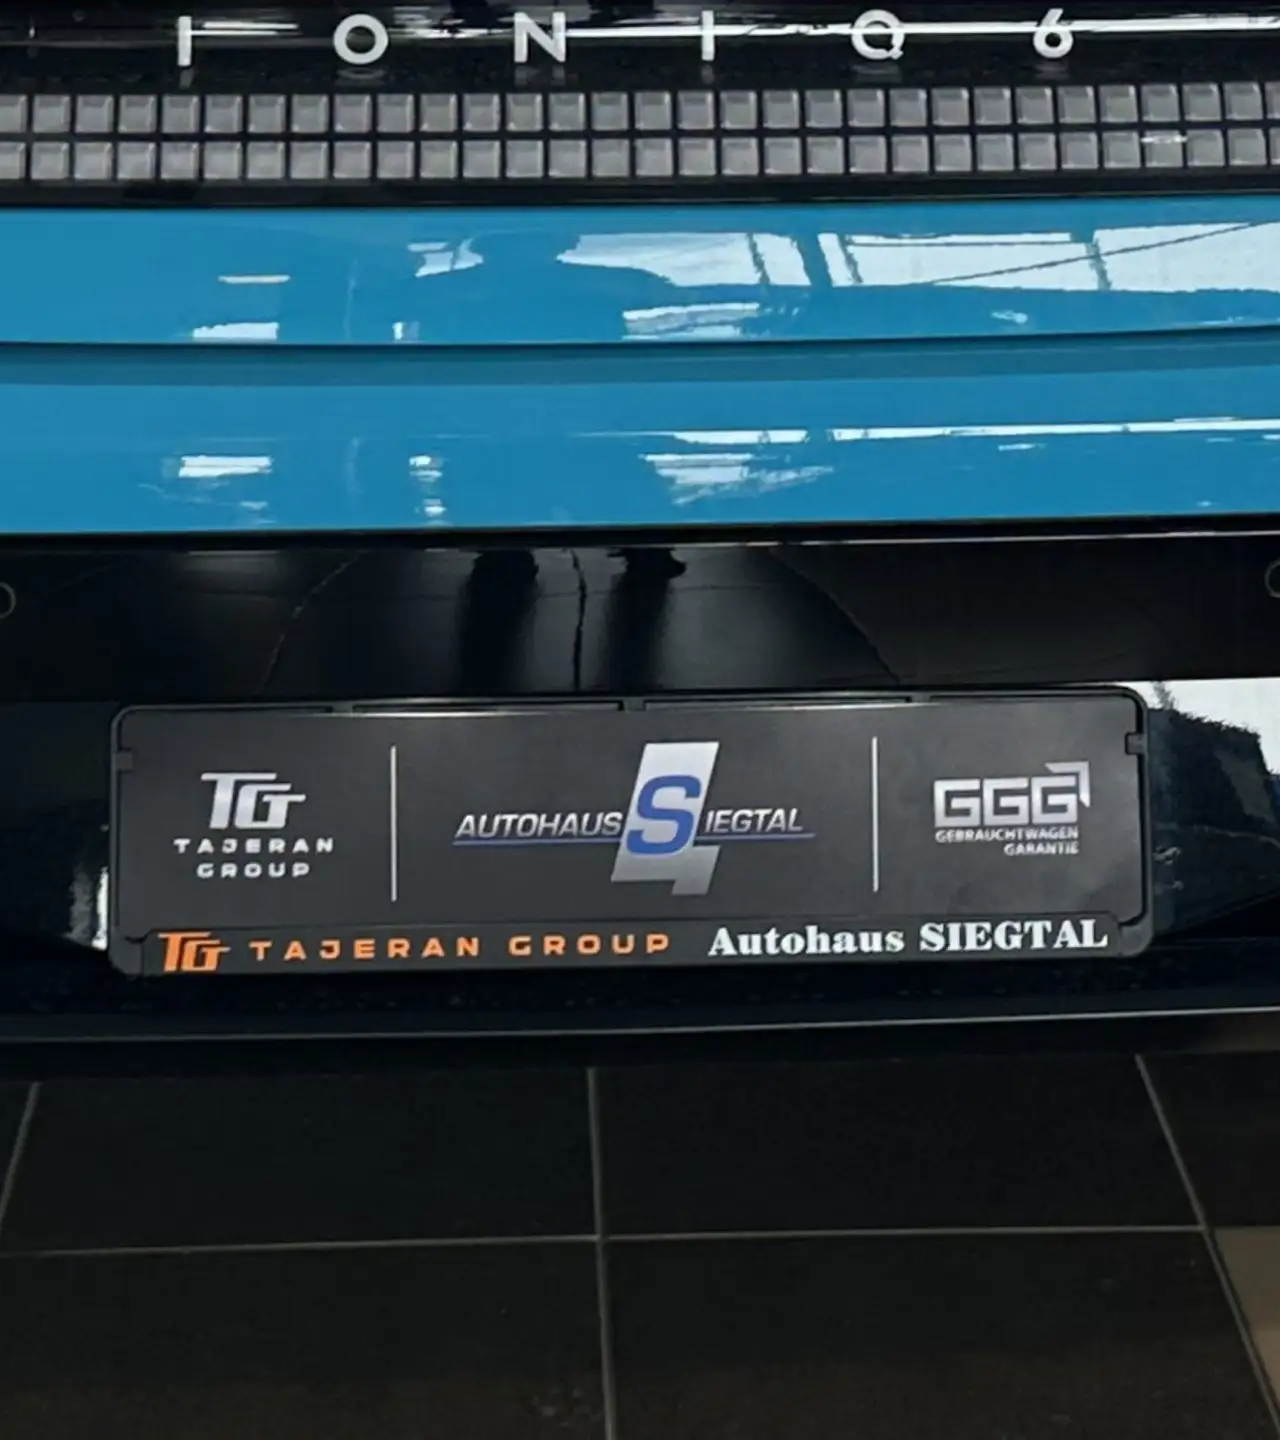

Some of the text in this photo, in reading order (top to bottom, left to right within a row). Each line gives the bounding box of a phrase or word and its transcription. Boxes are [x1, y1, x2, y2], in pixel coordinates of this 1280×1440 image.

[177, 8, 1074, 67] IONIQ 6
[454, 774, 804, 856] AUTOHAUS SIEGTAL
[933, 774, 1078, 828] GGG
[173, 837, 334, 854] TAJERAN
[934, 825, 1079, 844] GEBRAUCHTWAGEN
[1003, 842, 1080, 857] GARANTIE
[196, 862, 310, 878] GROUP
[248, 935, 480, 961] TAJERAN
[508, 933, 670, 957] GROUP
[707, 924, 906, 956] Autohaus
[919, 918, 1109, 953] SIEGTAL
